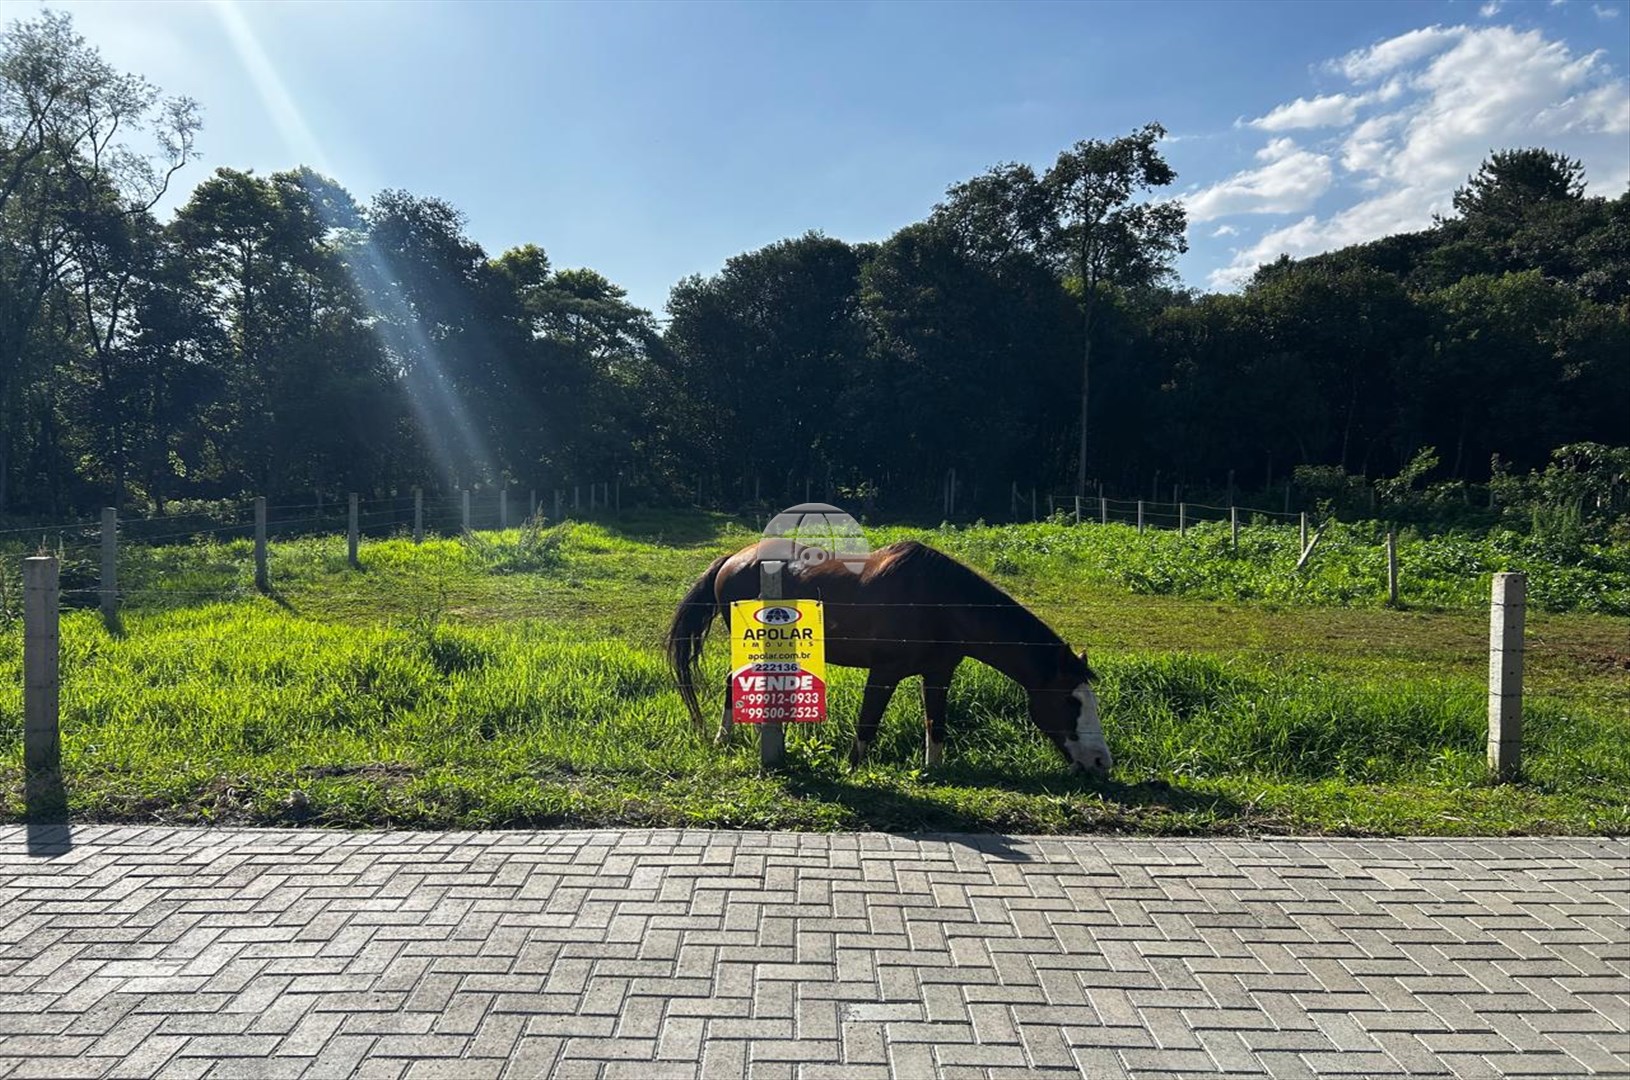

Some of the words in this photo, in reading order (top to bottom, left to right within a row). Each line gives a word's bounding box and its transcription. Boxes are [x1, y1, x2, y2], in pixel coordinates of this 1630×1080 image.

[743, 628, 813, 640] APOLAR
[748, 651, 811, 661] apolar.com.br
[755, 663, 798, 671] 222136
[738, 675, 813, 691] VENDE
[748, 692, 819, 705] 99912-0933
[748, 706, 819, 719] 99500-2525
